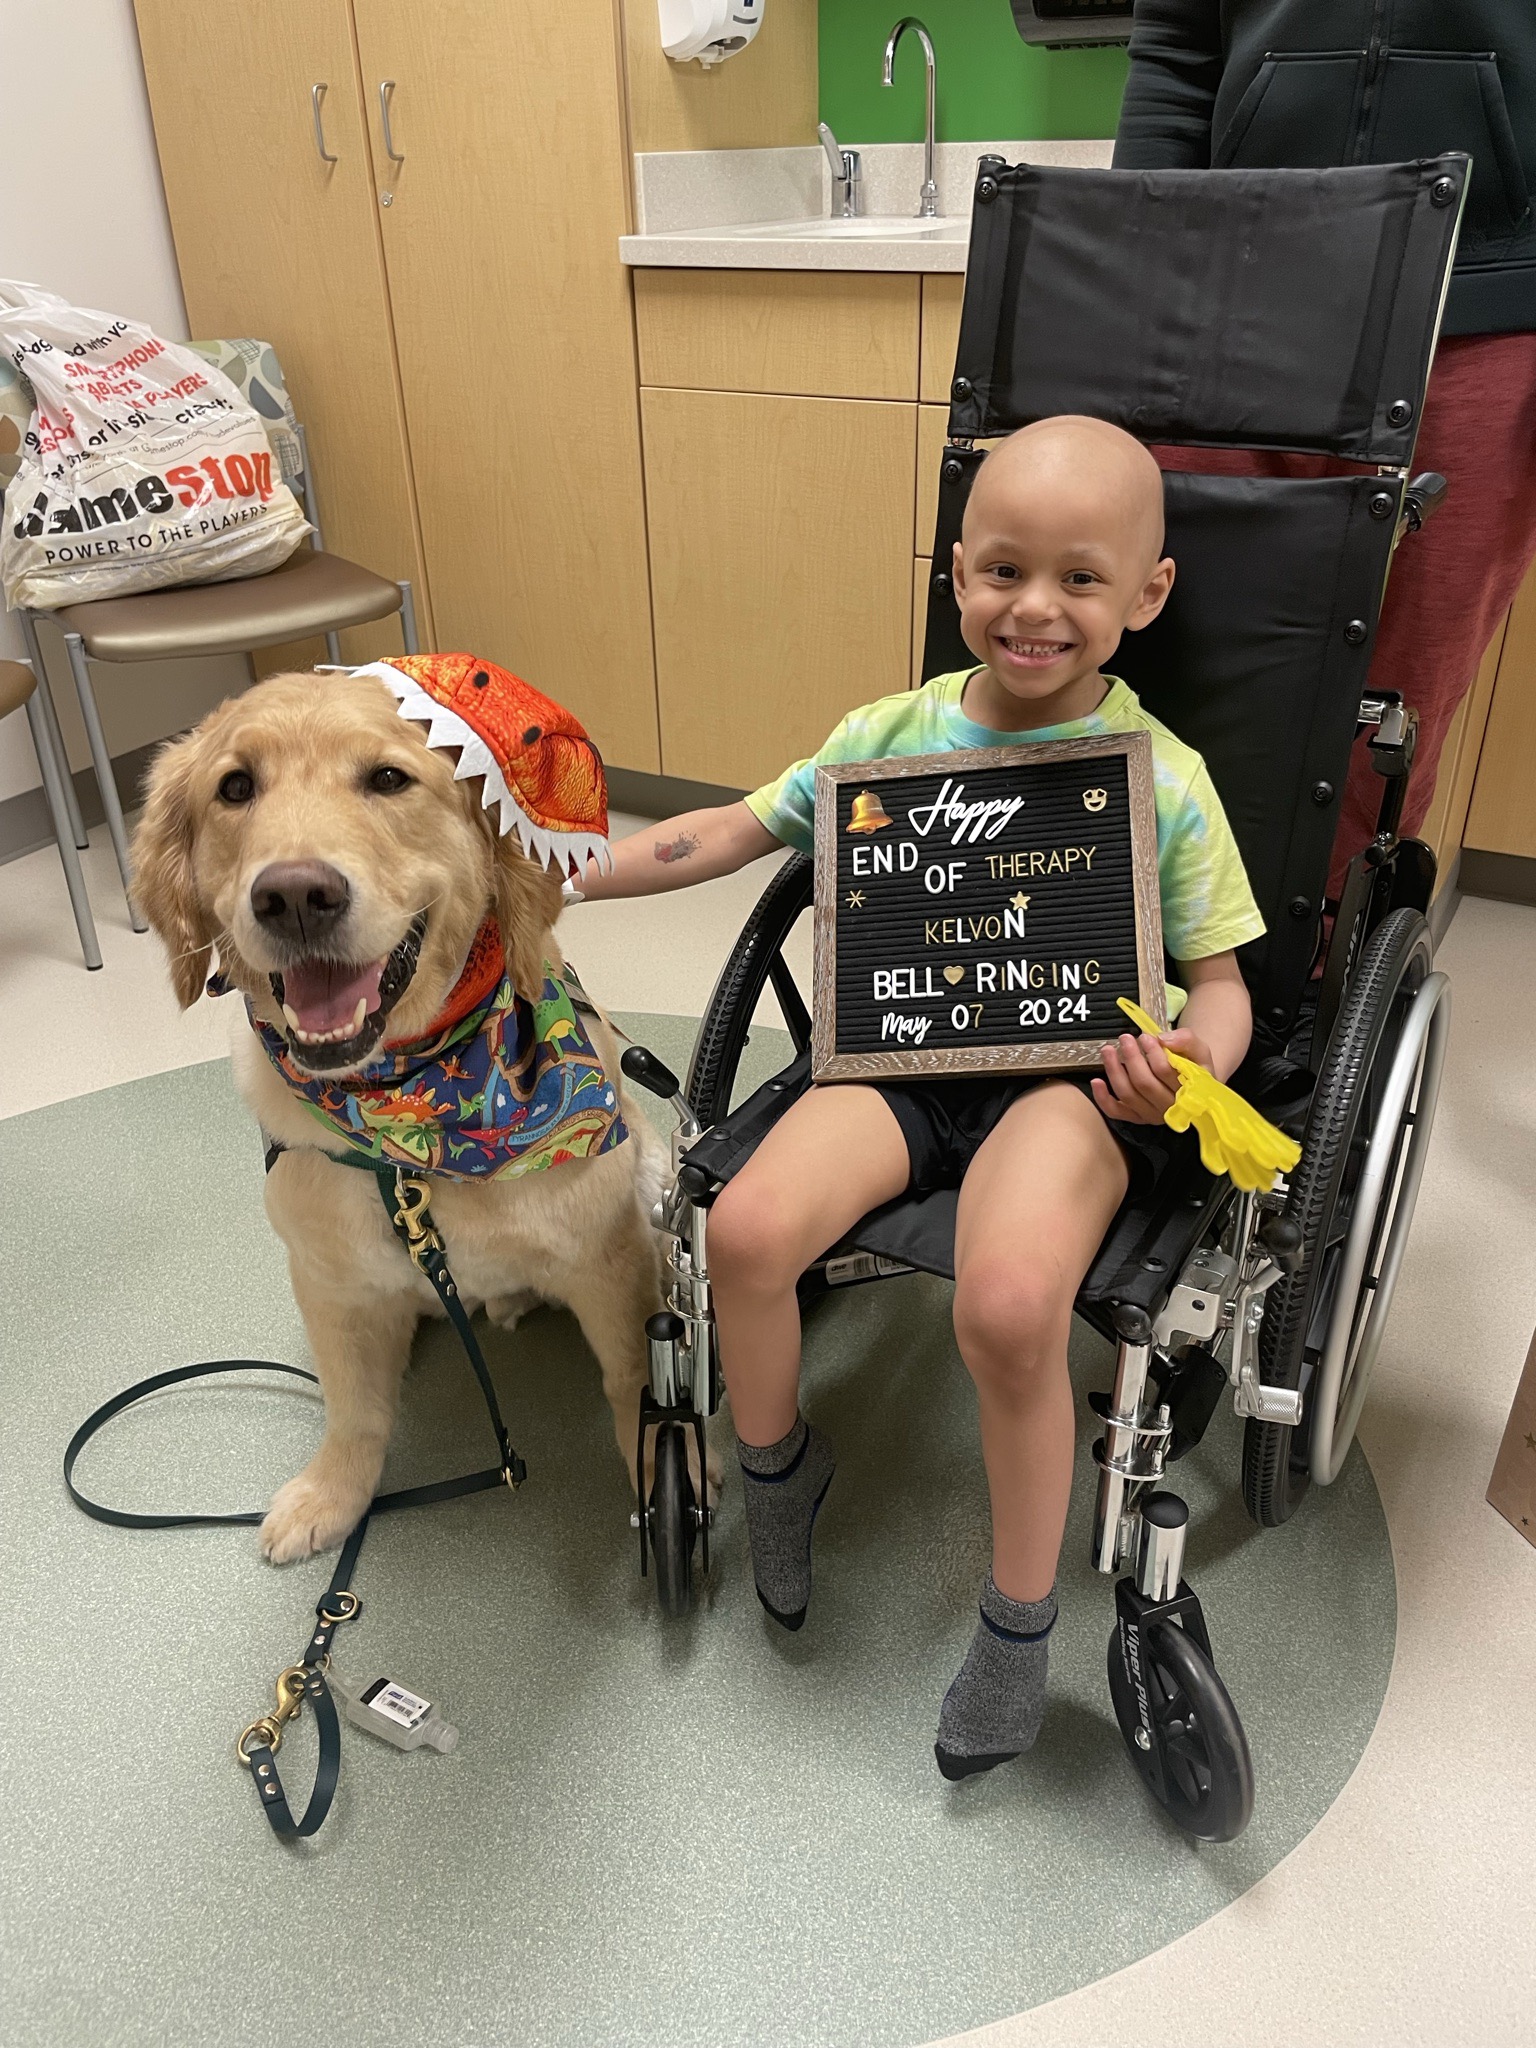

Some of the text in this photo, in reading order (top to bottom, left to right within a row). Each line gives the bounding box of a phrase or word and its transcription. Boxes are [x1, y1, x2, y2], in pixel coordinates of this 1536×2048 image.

[45, 540, 120, 564] POWER
[126, 534, 152, 551] TO
[159, 524, 194, 544] THE
[199, 503, 268, 535] PLAYERS
[907, 778, 1025, 845] Happy
[852, 842, 1097, 895] END OF THERAPY
[924, 908, 1025, 945] KELVON
[873, 959, 1101, 1001] BELL RINGING
[881, 994, 1091, 1045] May 07 2024
[1126, 1623, 1150, 1731] Viper Plus
